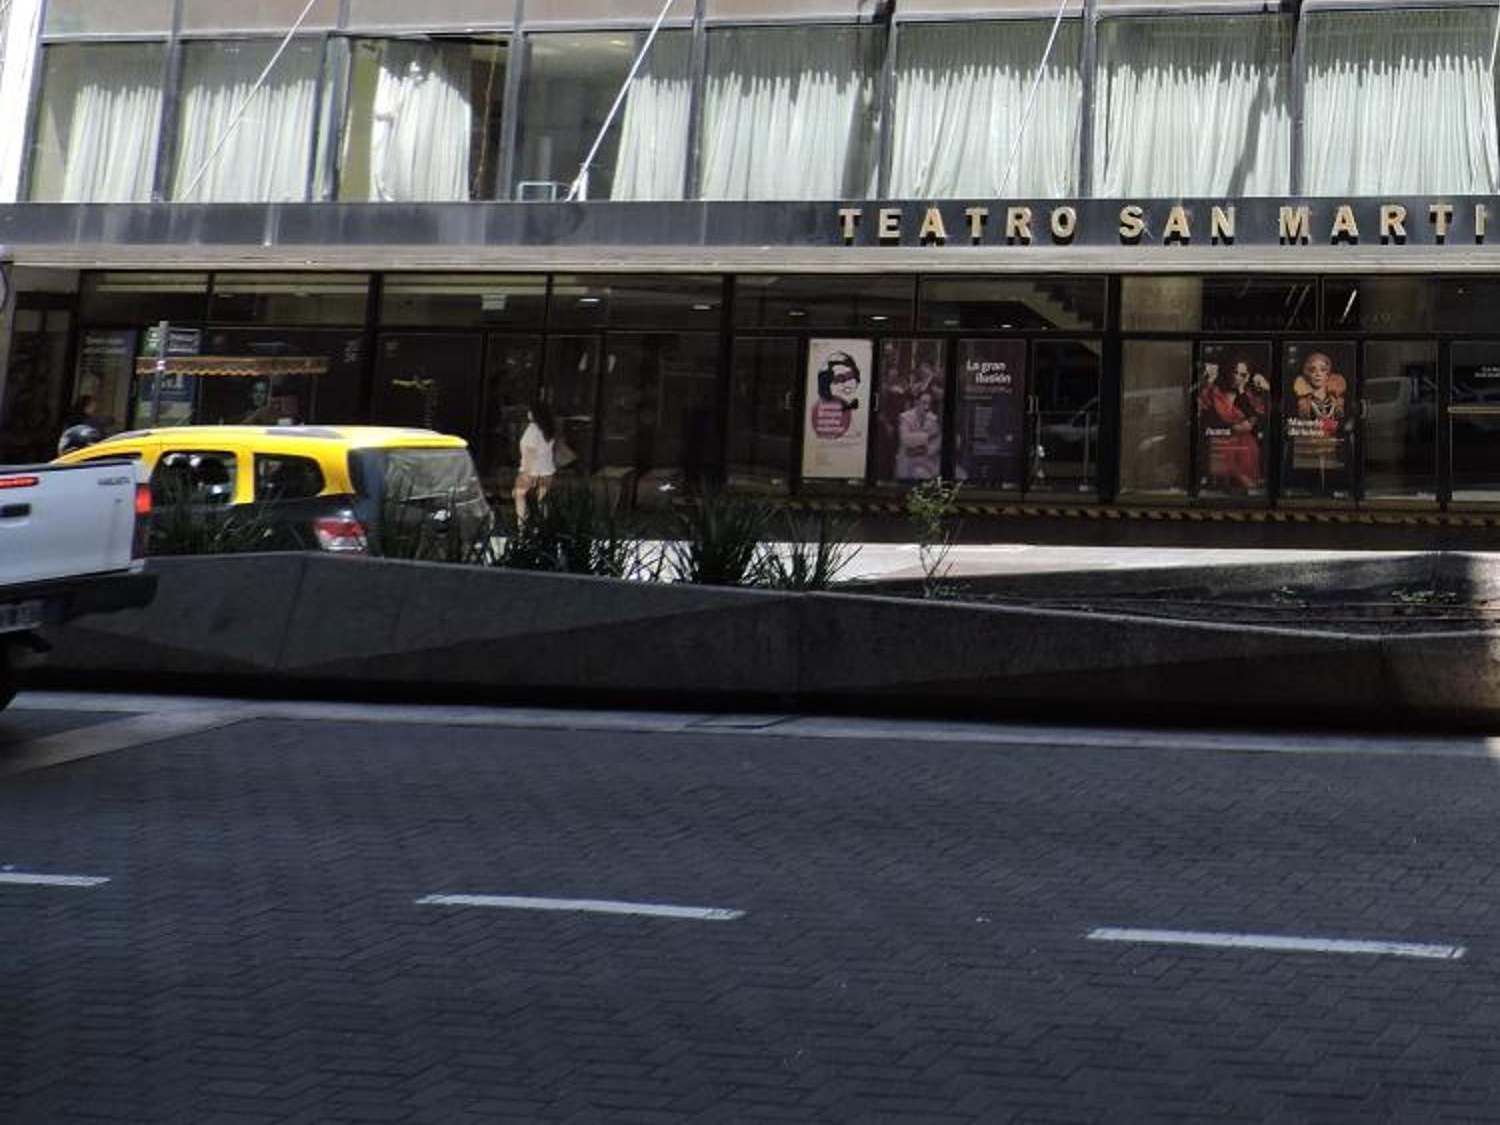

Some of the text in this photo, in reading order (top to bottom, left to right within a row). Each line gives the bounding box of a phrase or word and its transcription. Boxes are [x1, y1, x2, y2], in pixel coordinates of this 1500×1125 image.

[838, 205, 1077, 240] TEATRO
[1119, 205, 1236, 240] SAN
[966, 360, 1006, 374] La gran
